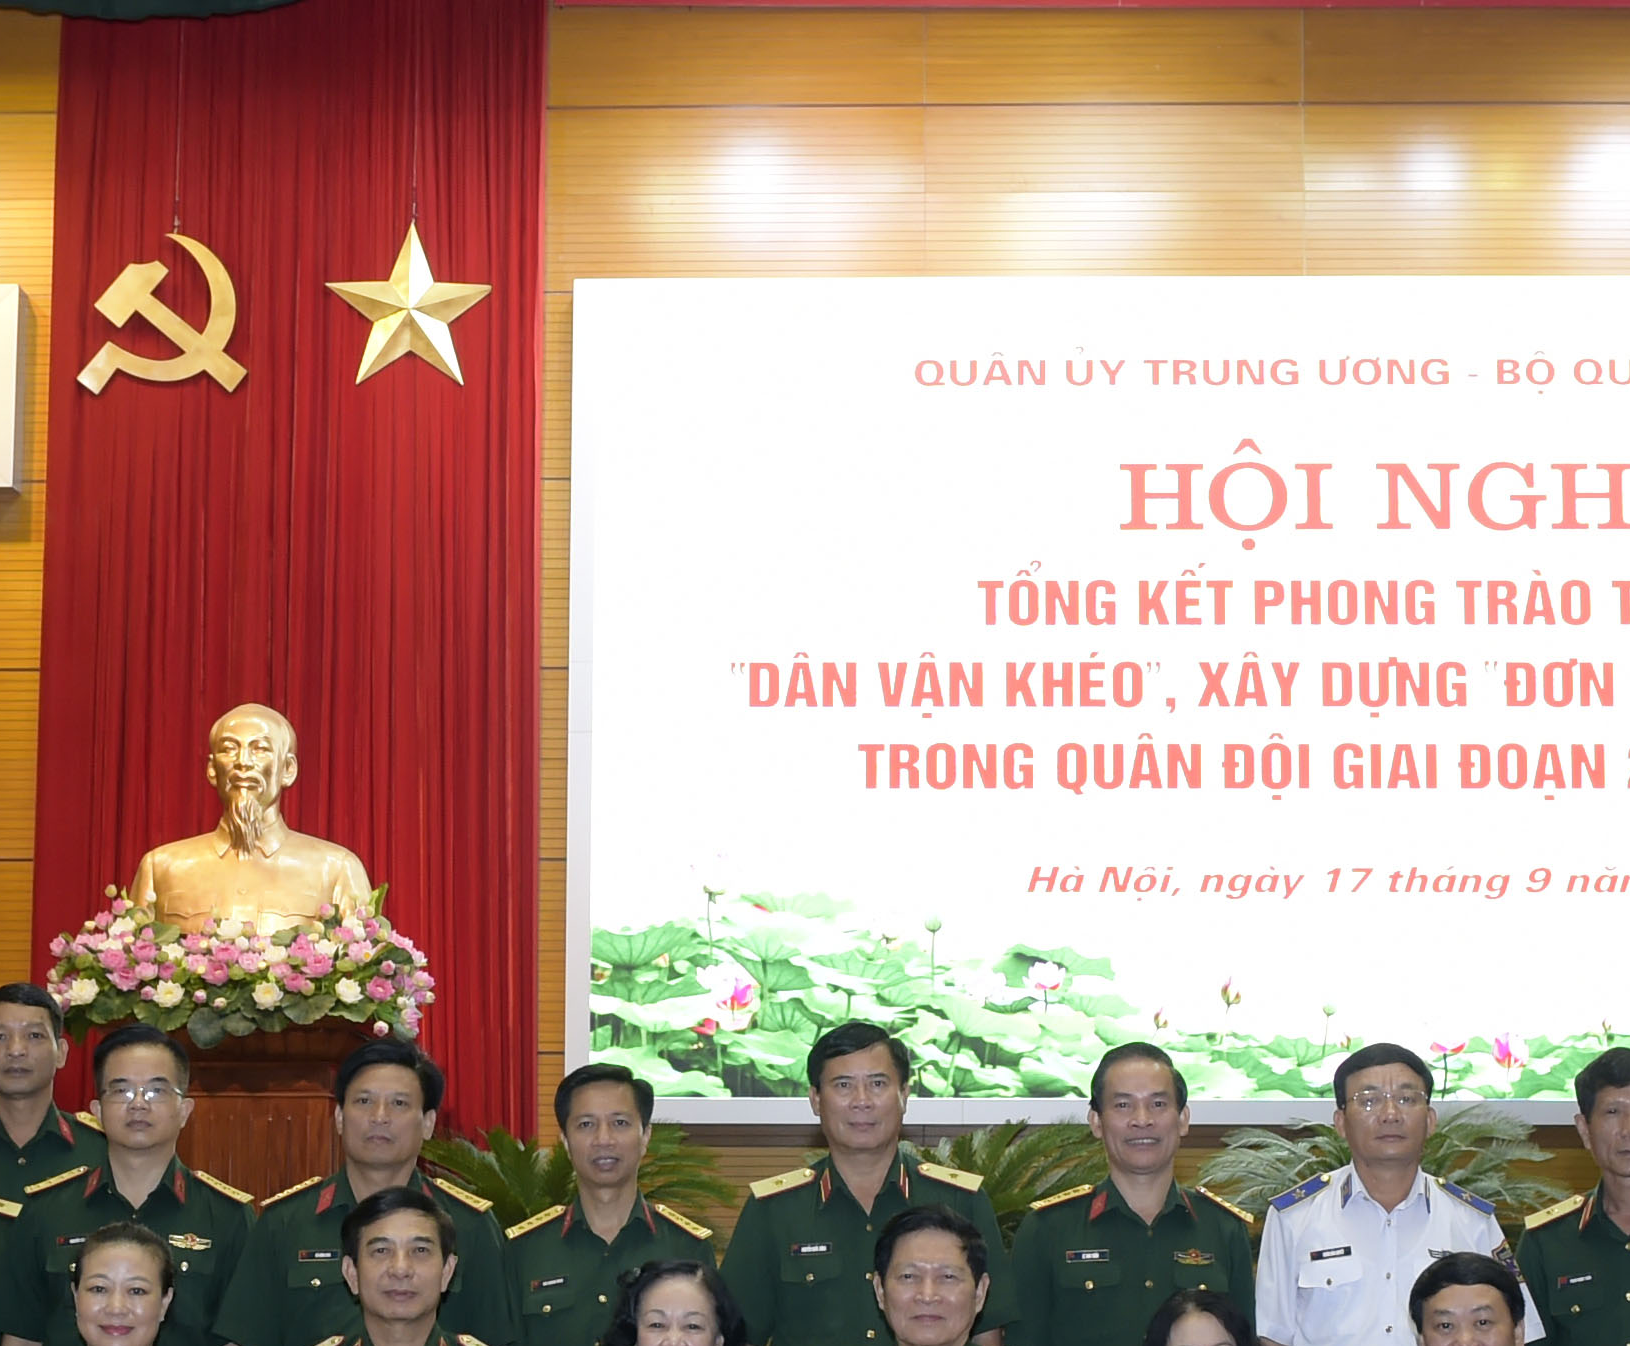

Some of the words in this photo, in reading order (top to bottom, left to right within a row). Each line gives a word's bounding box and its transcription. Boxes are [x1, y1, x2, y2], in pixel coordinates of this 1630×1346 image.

[914, 352, 1046, 387] QUÂN
[1066, 346, 1126, 387] ỦY
[1145, 359, 1299, 386] TRUNG
[1319, 356, 1449, 385] ƯƠNG
[1496, 351, 1556, 395] BỘ
[1121, 438, 1333, 550] HỘI
[977, 560, 1116, 626] TỔNG
[1138, 563, 1233, 625] KẾT
[1254, 579, 1436, 625] PHONG
[1457, 569, 1591, 626] TRÀO
[878, 652, 983, 718] VẬN
[1198, 651, 1300, 707] XÂY
[1322, 656, 1467, 718] DỰNG
[858, 743, 1033, 790] TRONG
[1057, 733, 1201, 795] QUÂN
[1222, 733, 1310, 800] ĐỘI
[1333, 743, 1438, 790] GIAI
[1459, 743, 1605, 800] ĐOẠN
[1028, 866, 1084, 893] Hà
[1099, 866, 1180, 901] Nội,
[1201, 866, 1305, 899] ngày
[1326, 868, 1373, 893] 17
[1389, 867, 1510, 899] tháng
[1526, 867, 1552, 893] 9
